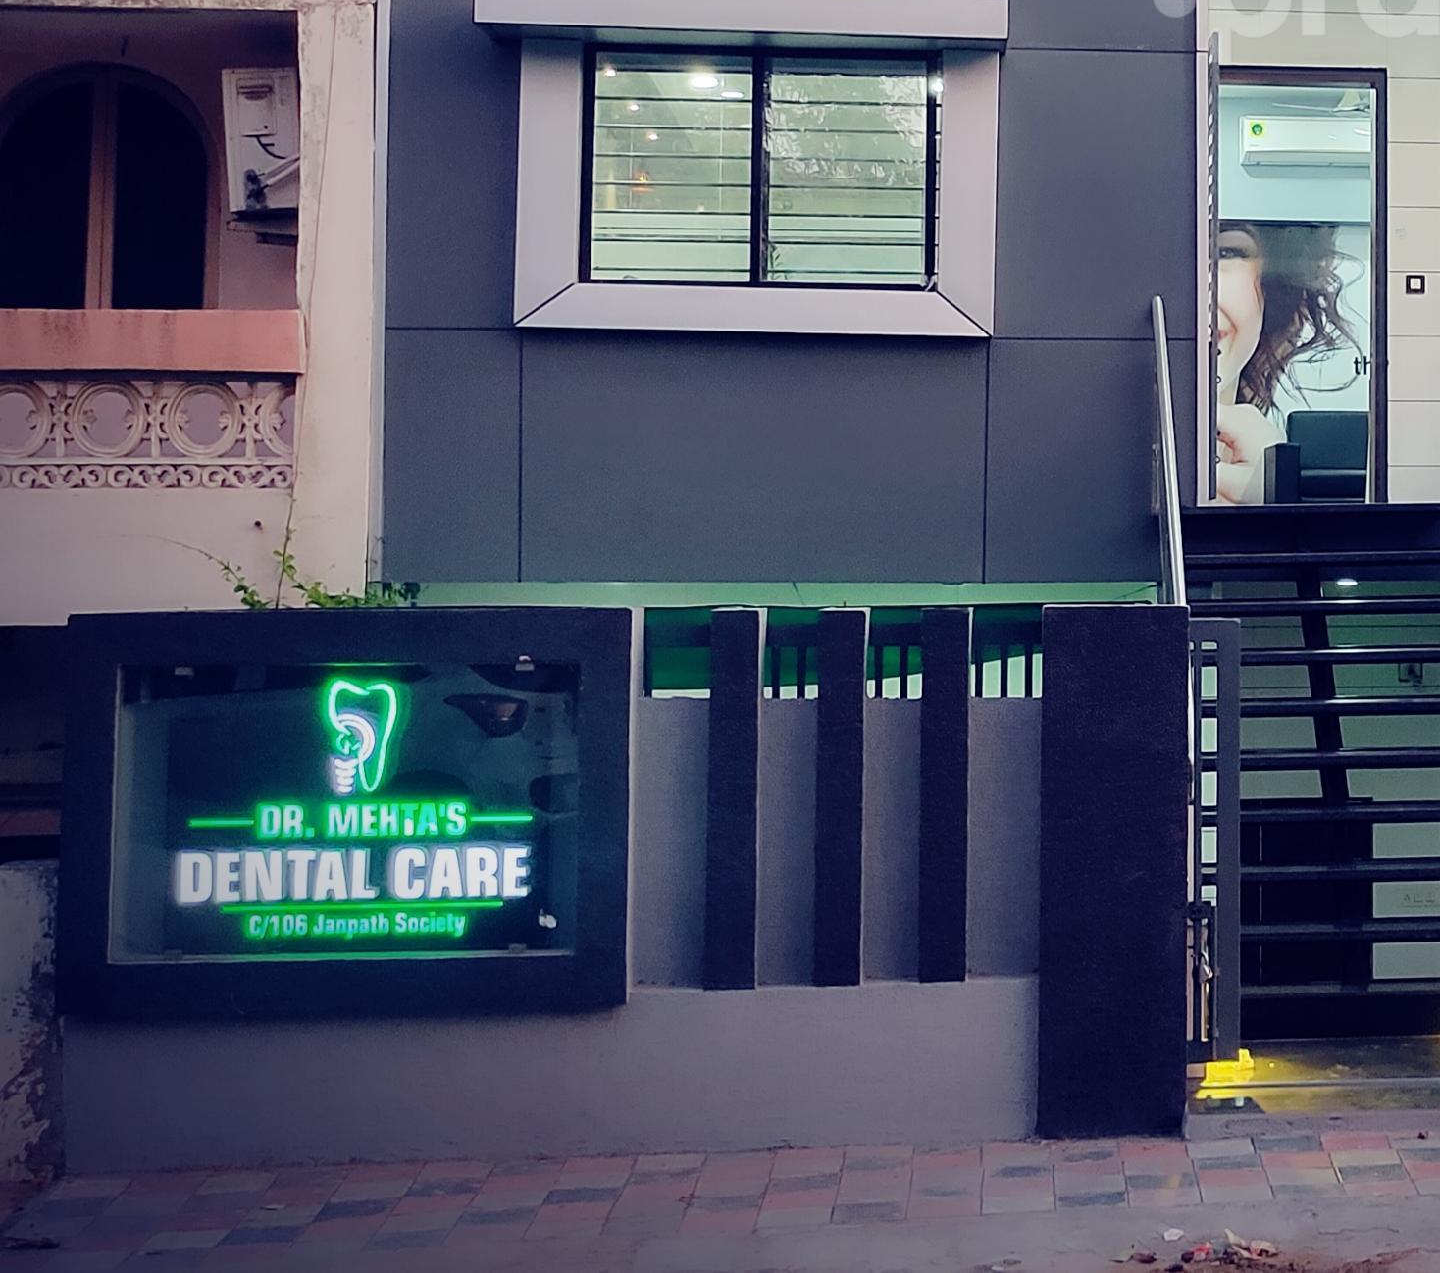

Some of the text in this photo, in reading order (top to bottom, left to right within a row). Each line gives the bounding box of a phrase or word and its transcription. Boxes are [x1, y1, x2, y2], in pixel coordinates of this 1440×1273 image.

[261, 802, 467, 838] DR. MEHTA'S
[178, 845, 532, 905] DENTAL CARE
[249, 912, 467, 940] C/106 Janpath Society
